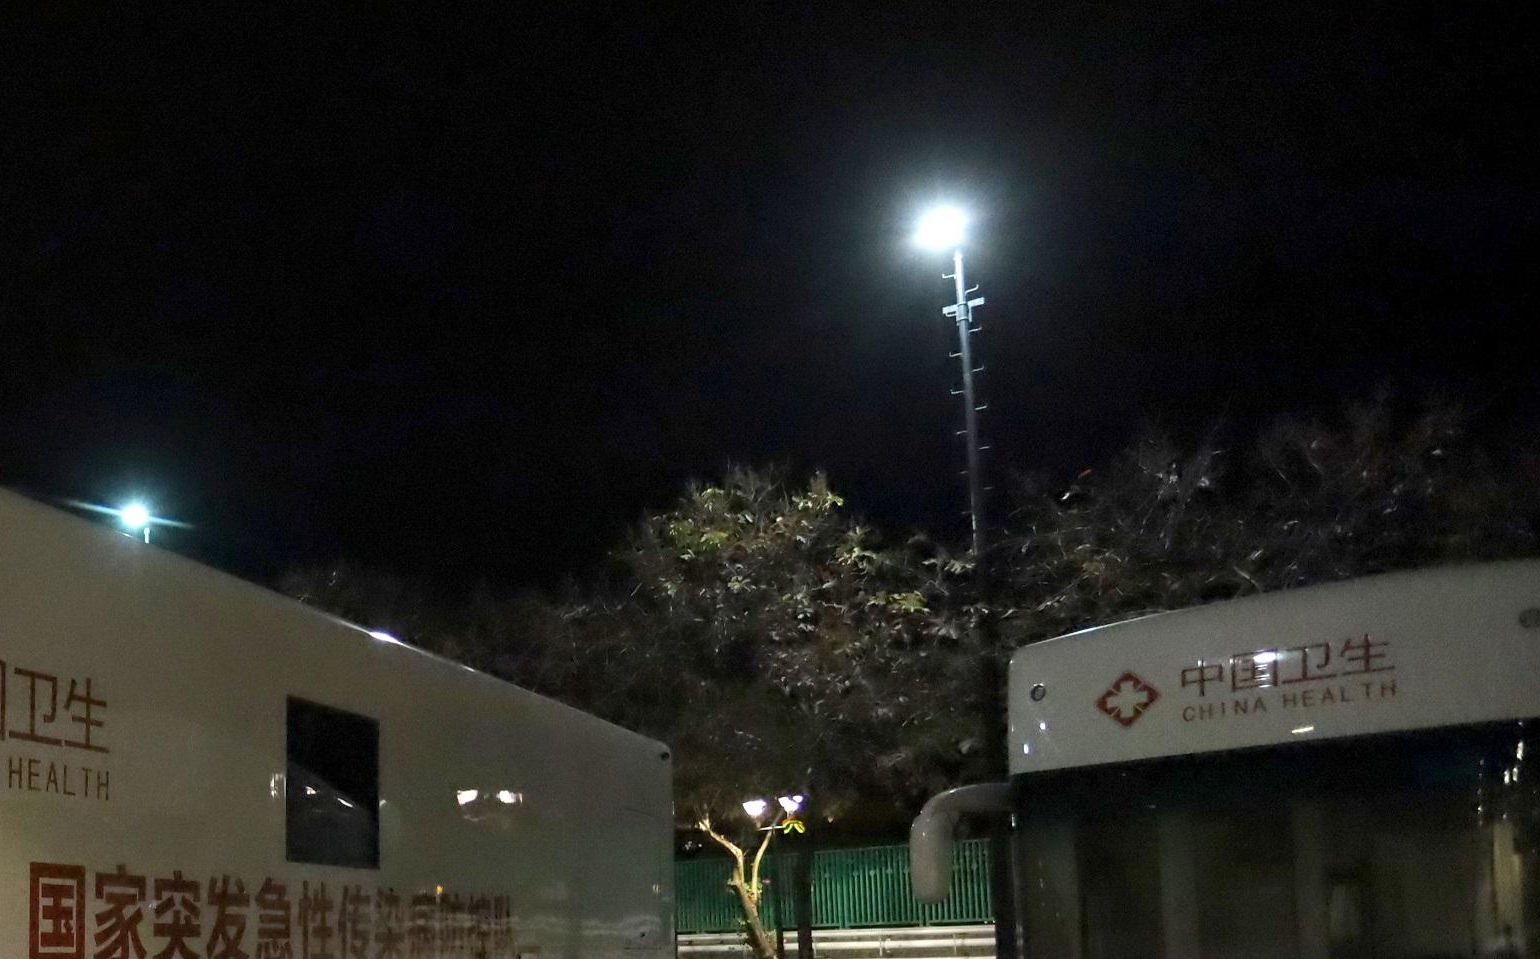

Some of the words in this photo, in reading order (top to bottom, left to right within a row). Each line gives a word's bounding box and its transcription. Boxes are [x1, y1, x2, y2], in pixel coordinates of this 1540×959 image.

[1180, 632, 1396, 697] 中国卫生
[1182, 697, 1268, 722] CHINA
[1282, 680, 1398, 708] HEALTH
[8, 756, 111, 801] HEALTH
